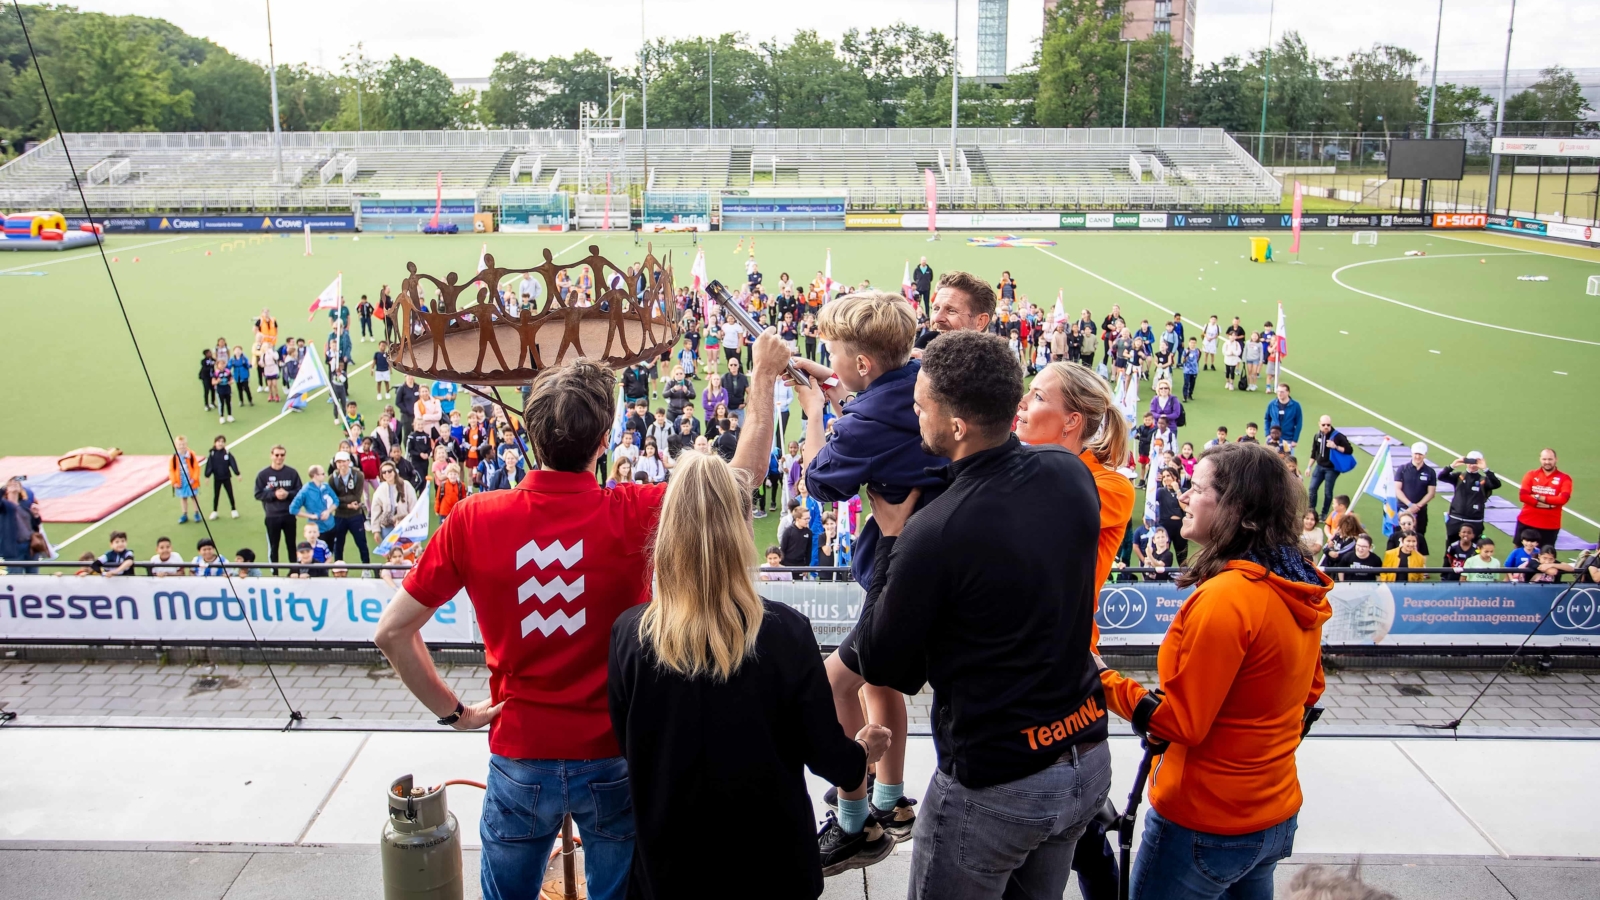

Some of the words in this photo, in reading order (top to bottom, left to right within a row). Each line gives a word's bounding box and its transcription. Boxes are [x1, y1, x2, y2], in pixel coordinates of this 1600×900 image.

[173, 218, 200, 228] Crowe
[275, 218, 302, 228] Crowe
[1436, 215, 1486, 227] D-SIGN
[1402, 596, 1500, 610] Persoonlijkheid
[1501, 597, 1516, 608] in
[1401, 611, 1542, 625] vastgoedmanagement
[1020, 695, 1105, 750] TeamNL
